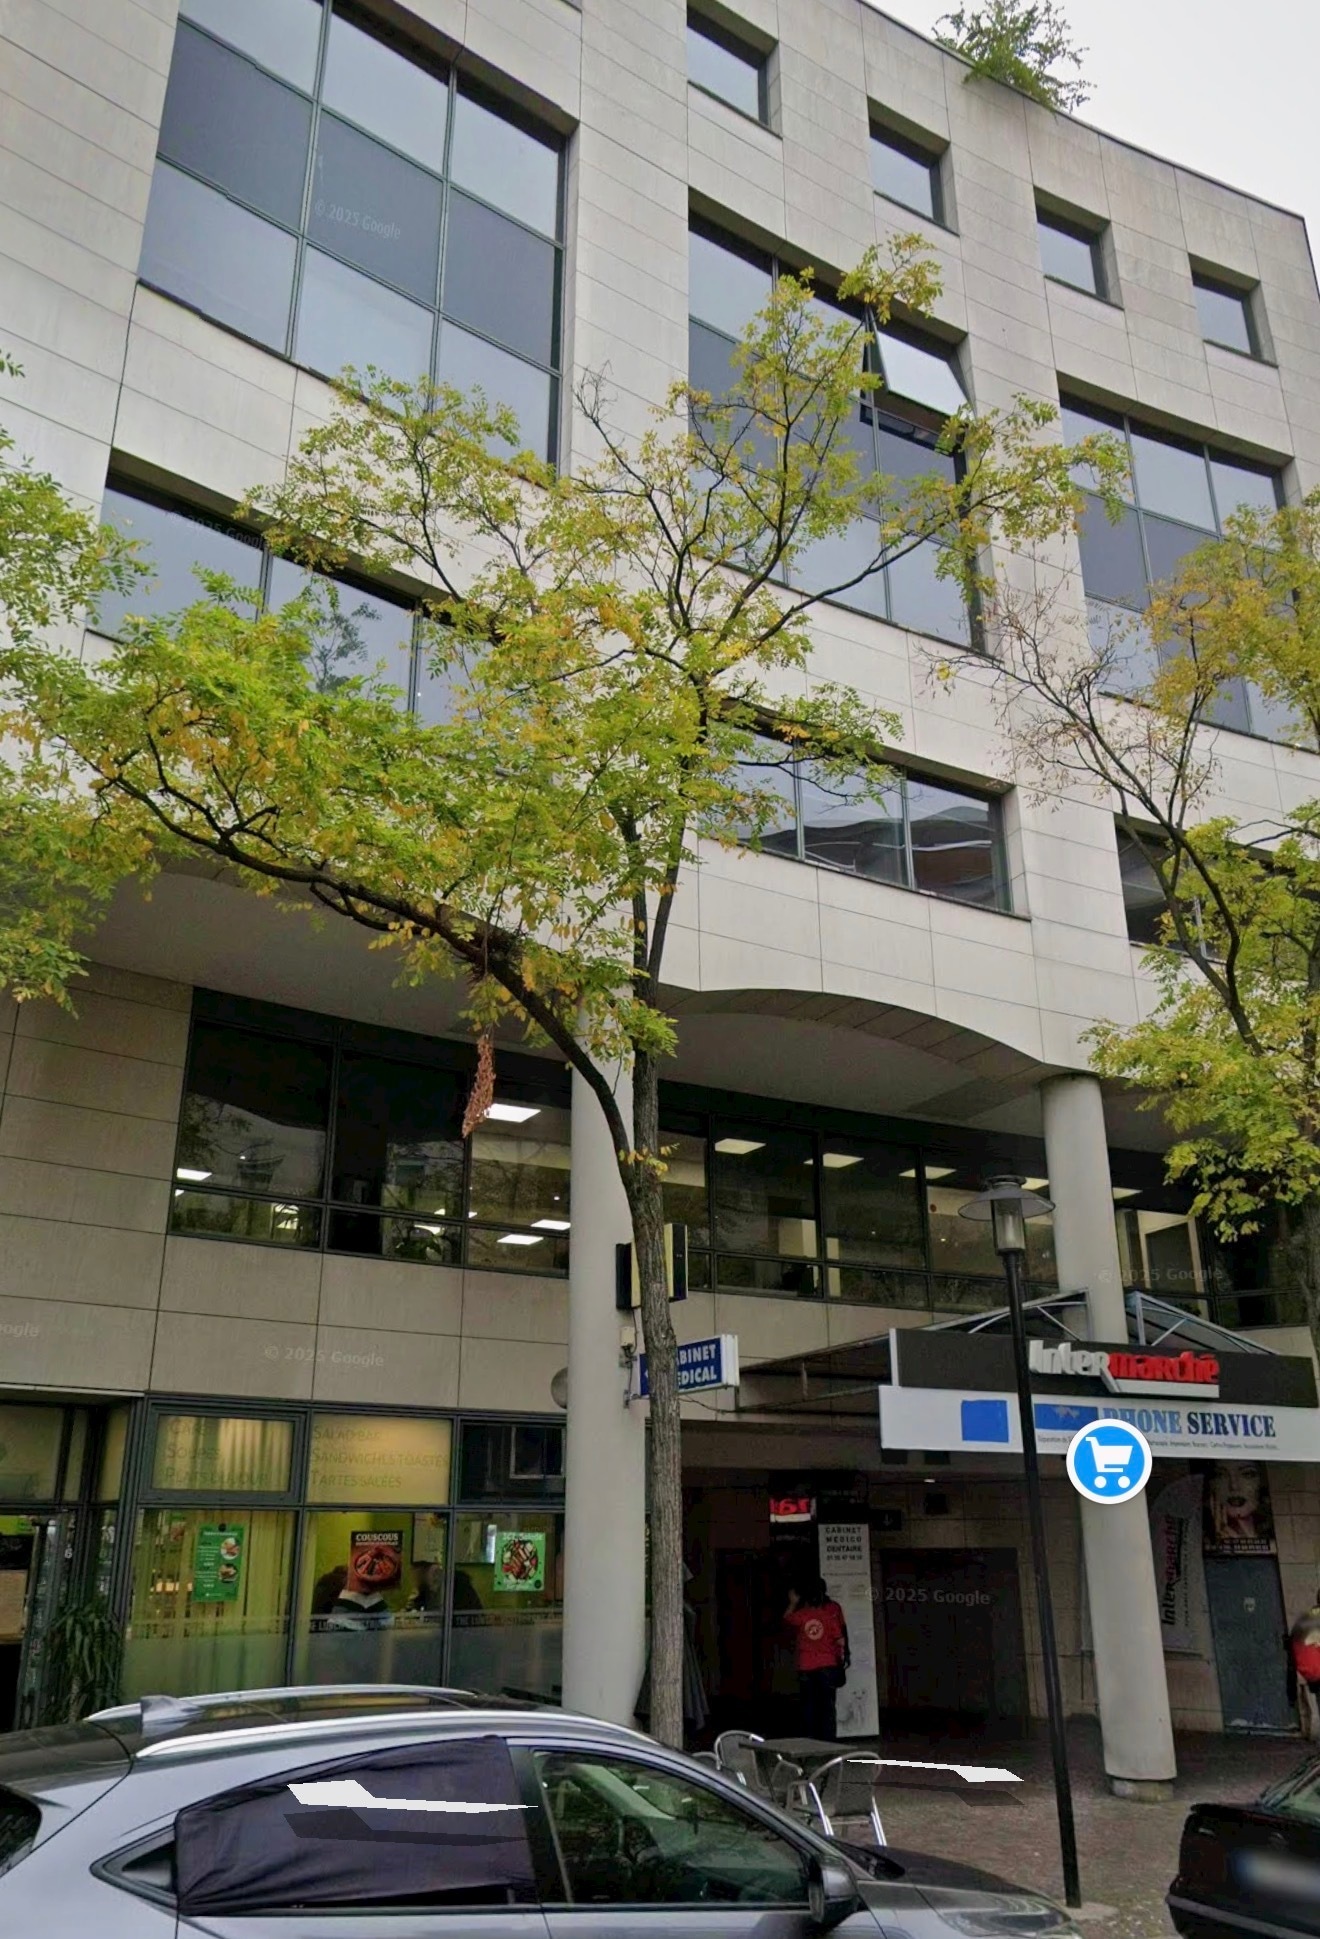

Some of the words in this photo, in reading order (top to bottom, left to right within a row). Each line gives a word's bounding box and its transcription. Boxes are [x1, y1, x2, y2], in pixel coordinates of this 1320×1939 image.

[676, 1344, 717, 1366] BINET
[1186, 1411, 1277, 1438] SERVICE
[355, 1532, 399, 1543] COUSCOUS
[825, 1526, 862, 1534] CABINET
